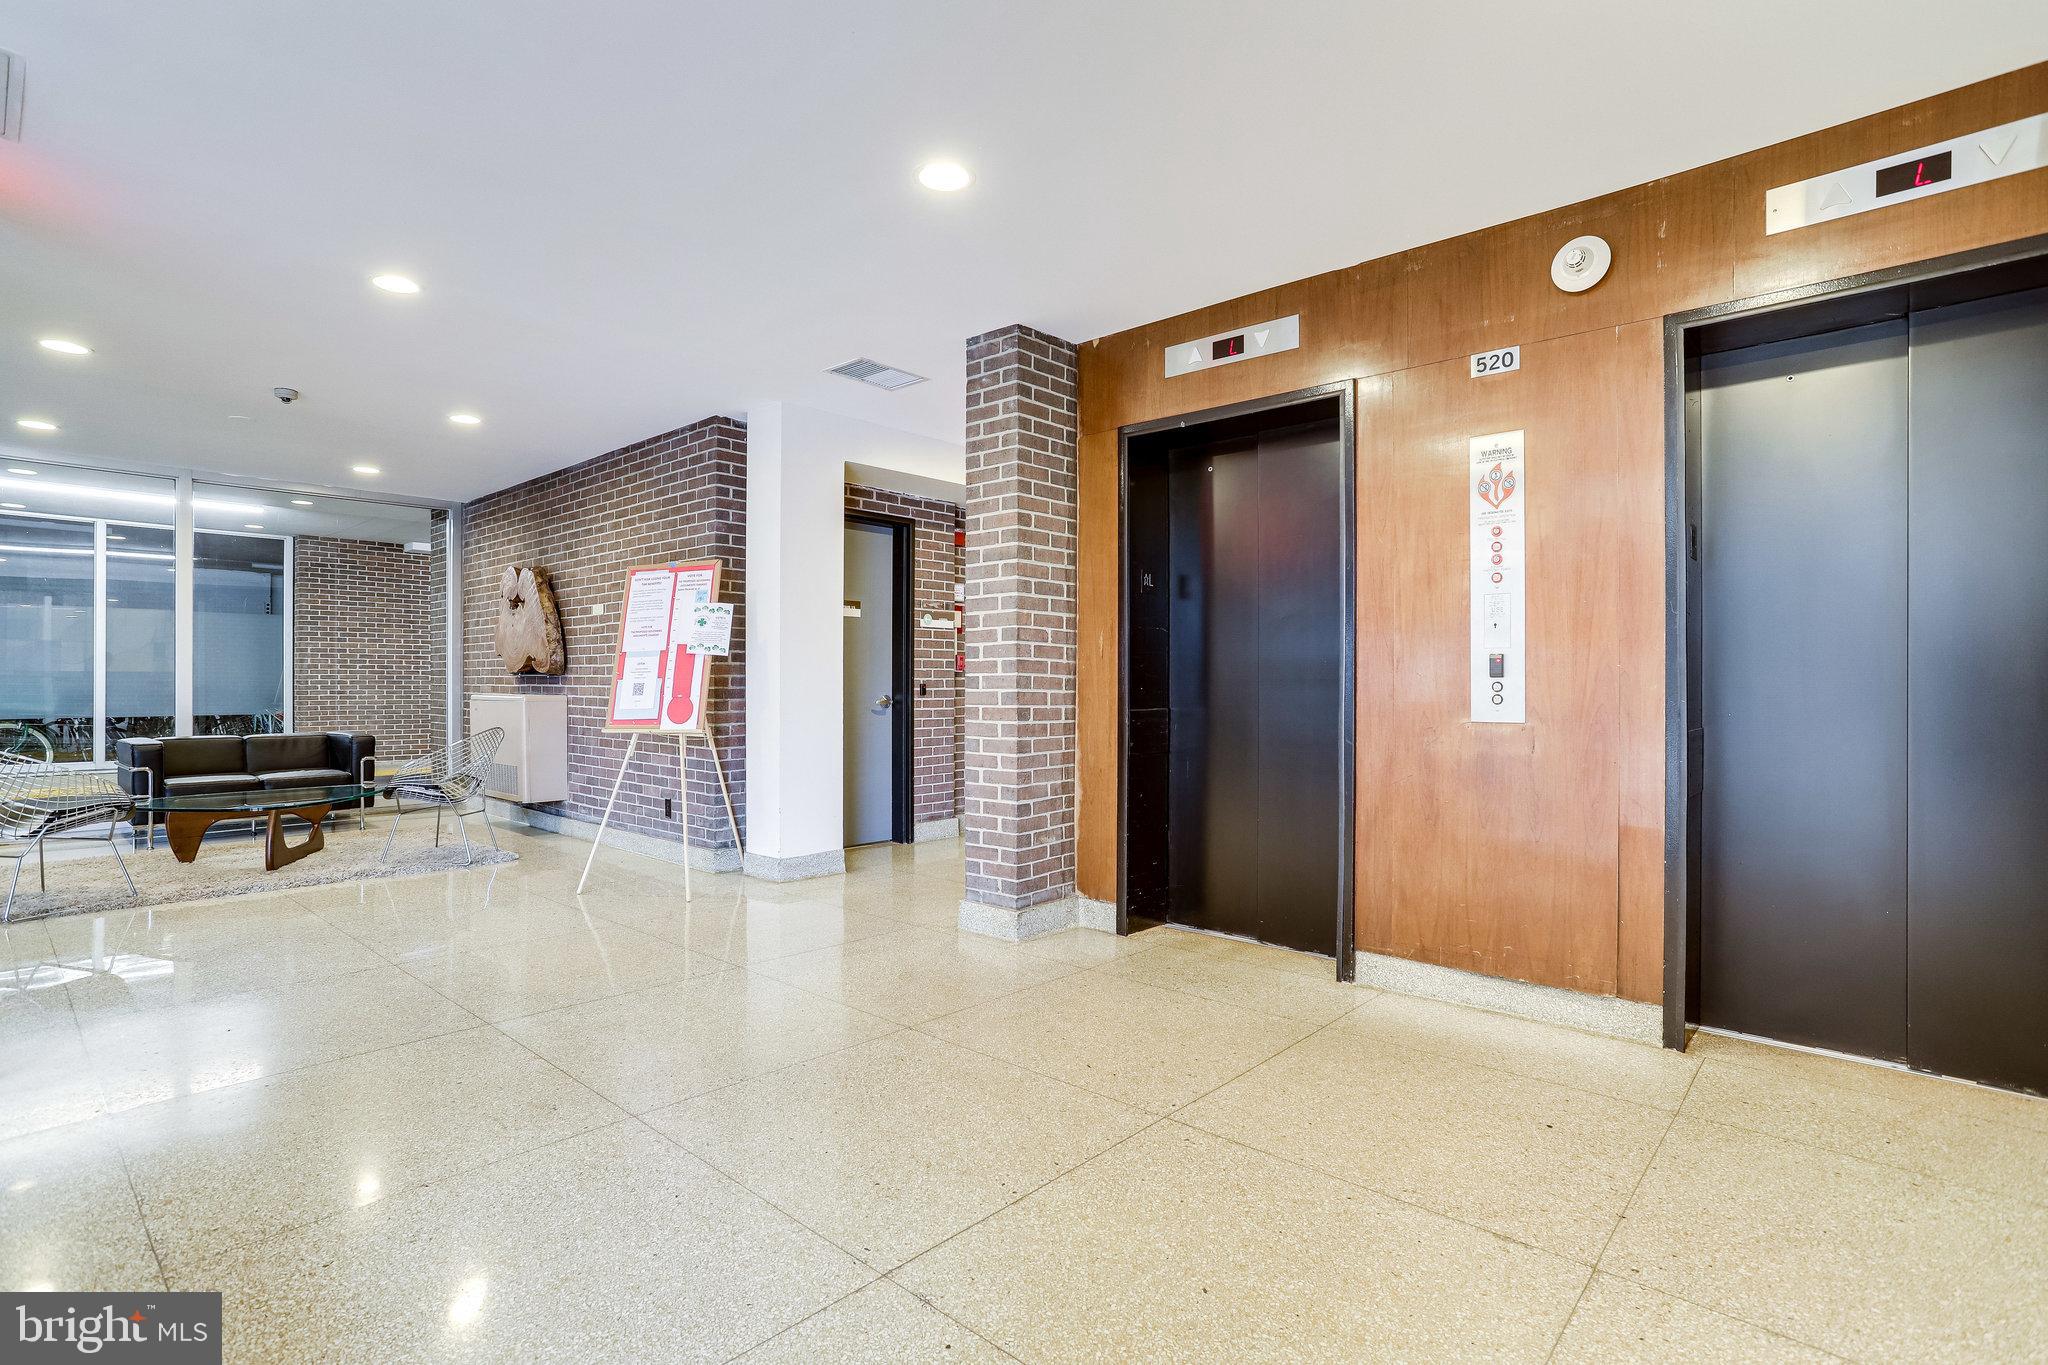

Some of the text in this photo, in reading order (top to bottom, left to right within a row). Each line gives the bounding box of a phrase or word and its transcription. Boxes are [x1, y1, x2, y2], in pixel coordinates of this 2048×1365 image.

[1914, 162, 1932, 186] L
[1229, 340, 1237, 355] L
[1476, 351, 1514, 373] 520
[1480, 447, 1513, 458] WARNING
